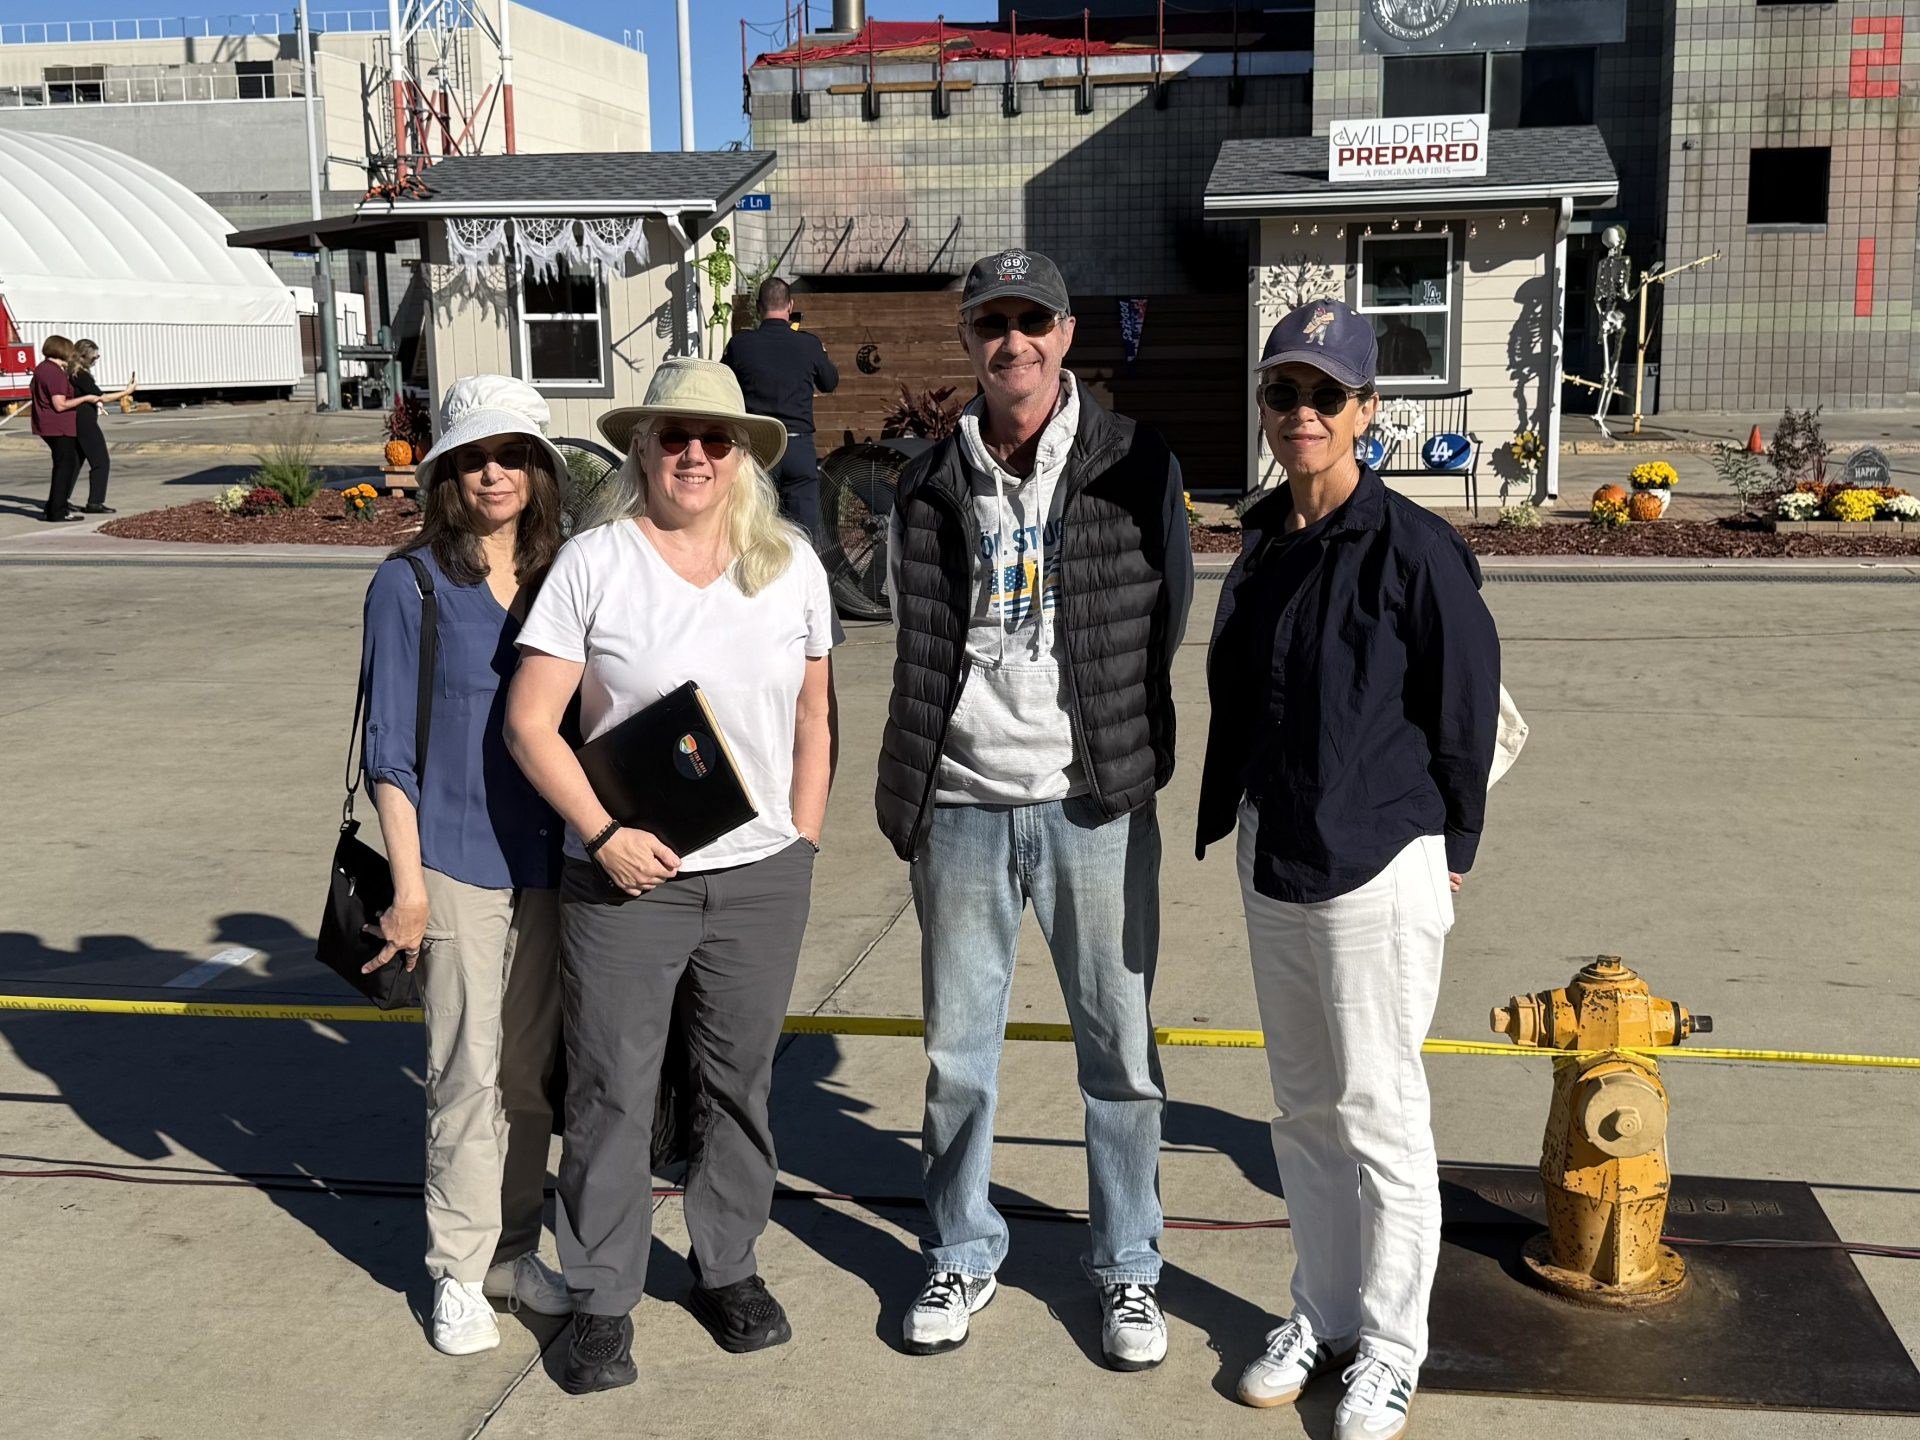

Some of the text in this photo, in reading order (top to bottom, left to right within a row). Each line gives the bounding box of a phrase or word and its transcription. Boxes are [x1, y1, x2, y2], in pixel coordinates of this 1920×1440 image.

[1343, 121, 1465, 146] WILDFIRE
[1338, 143, 1478, 167] PREPARED
[1364, 170, 1371, 178] A
[1373, 168, 1416, 177] PROGRAM
[1417, 167, 1429, 175] OF
[735, 196, 763, 208] er Ln
[1004, 258, 1021, 267] 69
[1423, 280, 1442, 304] LA
[1430, 436, 1454, 462] LA
[1855, 467, 1881, 478] HAPPY
